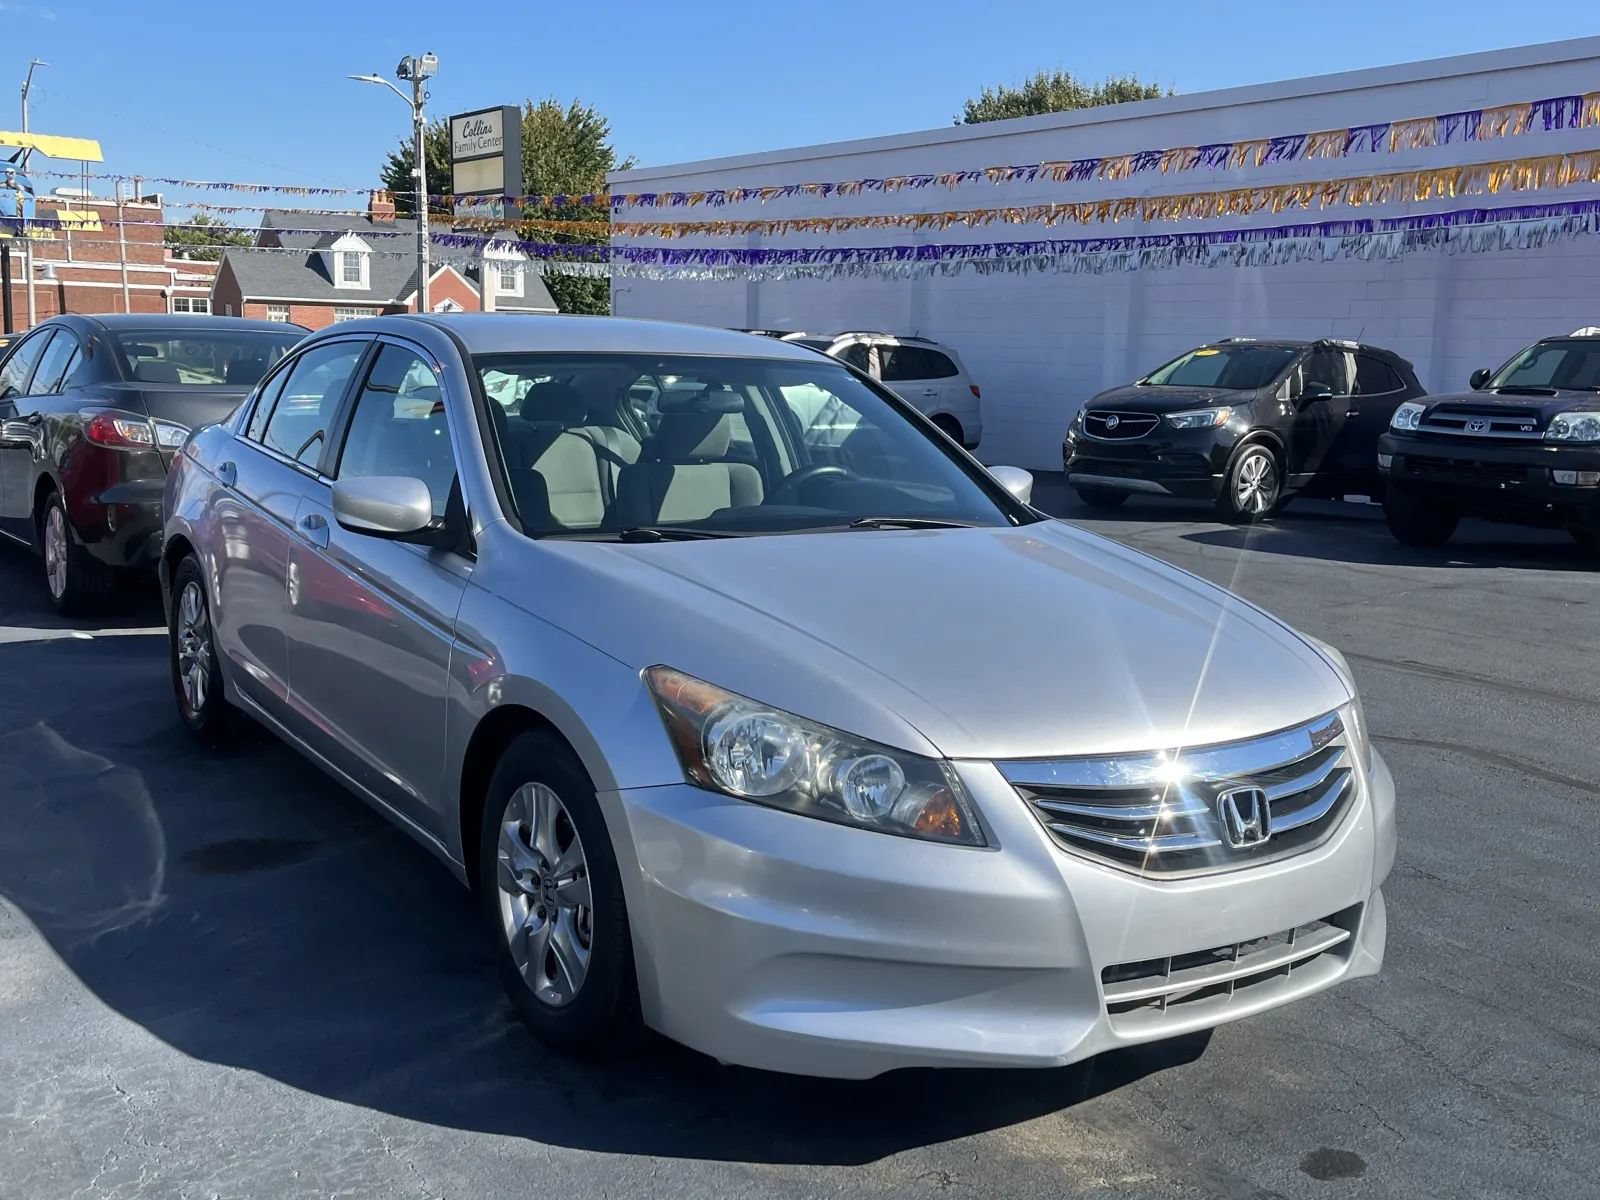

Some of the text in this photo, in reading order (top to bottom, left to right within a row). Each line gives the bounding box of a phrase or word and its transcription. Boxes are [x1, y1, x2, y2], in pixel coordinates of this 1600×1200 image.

[463, 120, 492, 138] Collins
[454, 136, 503, 154] Family Center
